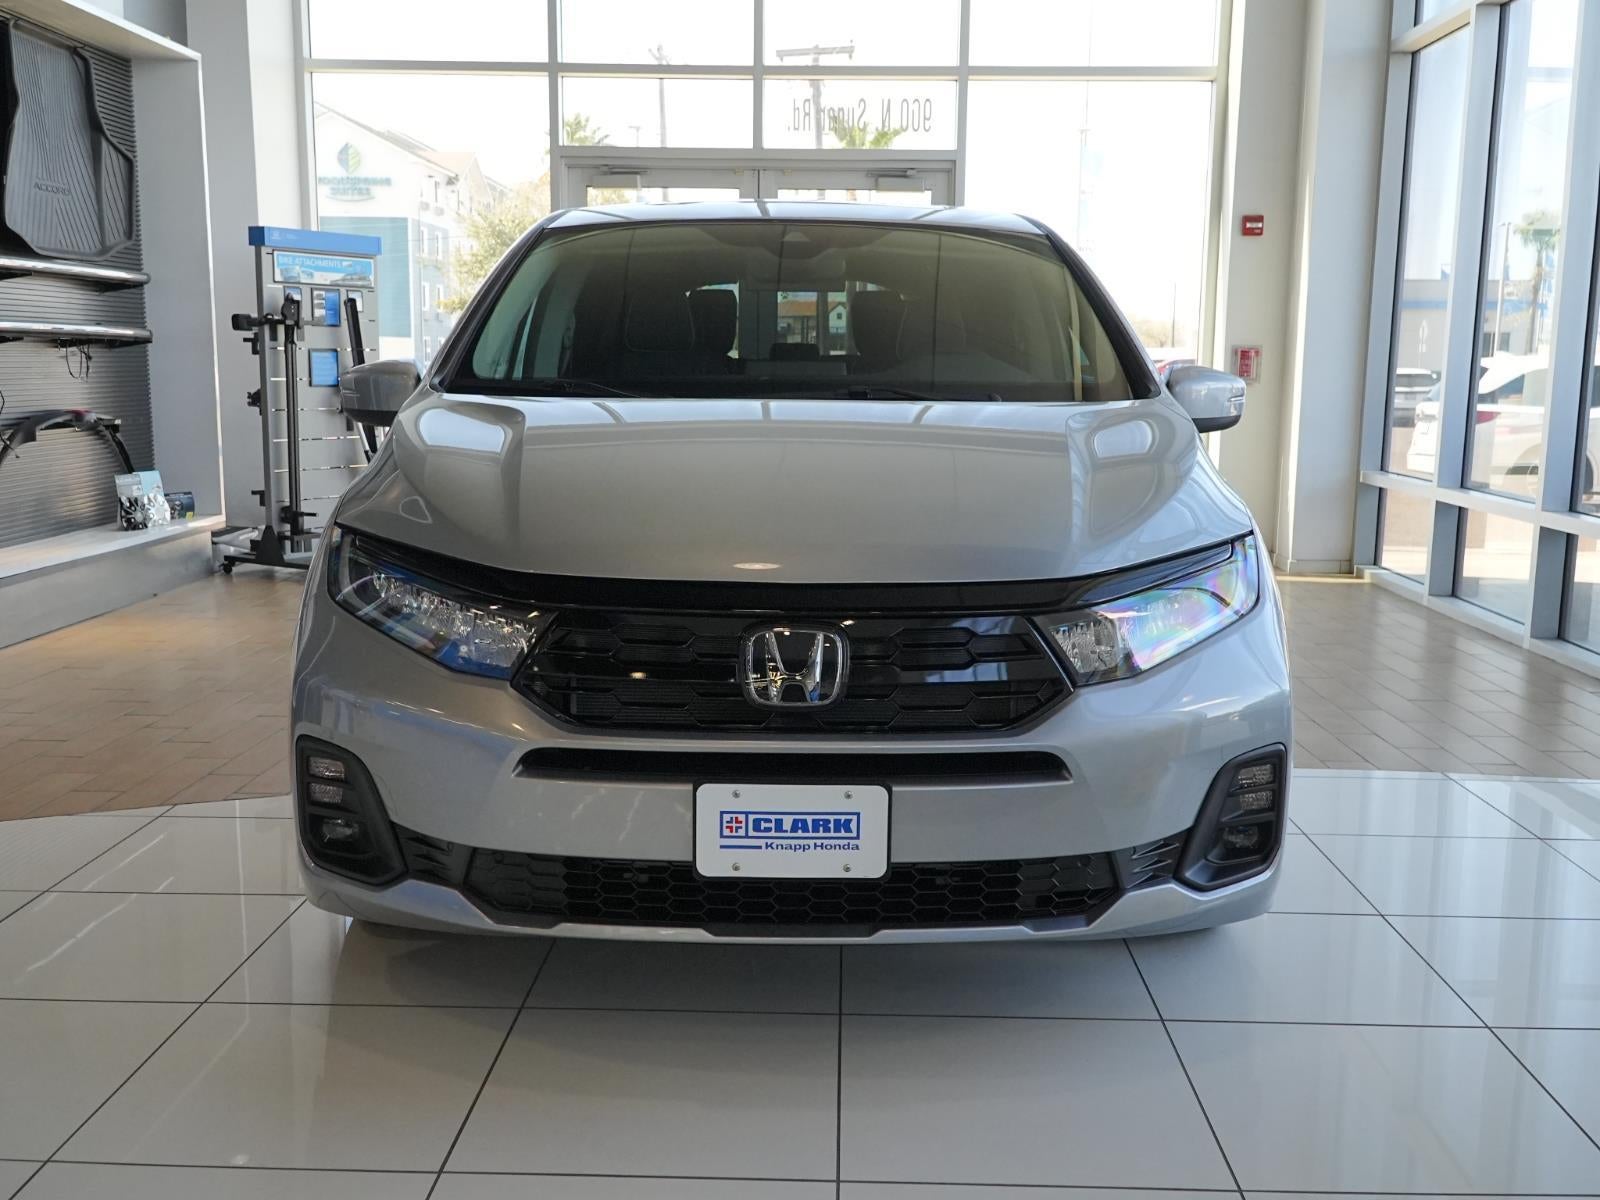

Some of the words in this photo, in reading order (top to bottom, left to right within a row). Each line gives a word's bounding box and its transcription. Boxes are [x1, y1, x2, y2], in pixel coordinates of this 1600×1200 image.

[752, 817, 853, 834] CLARK
[764, 841, 811, 852] Knapp
[813, 842, 860, 851] Honda
